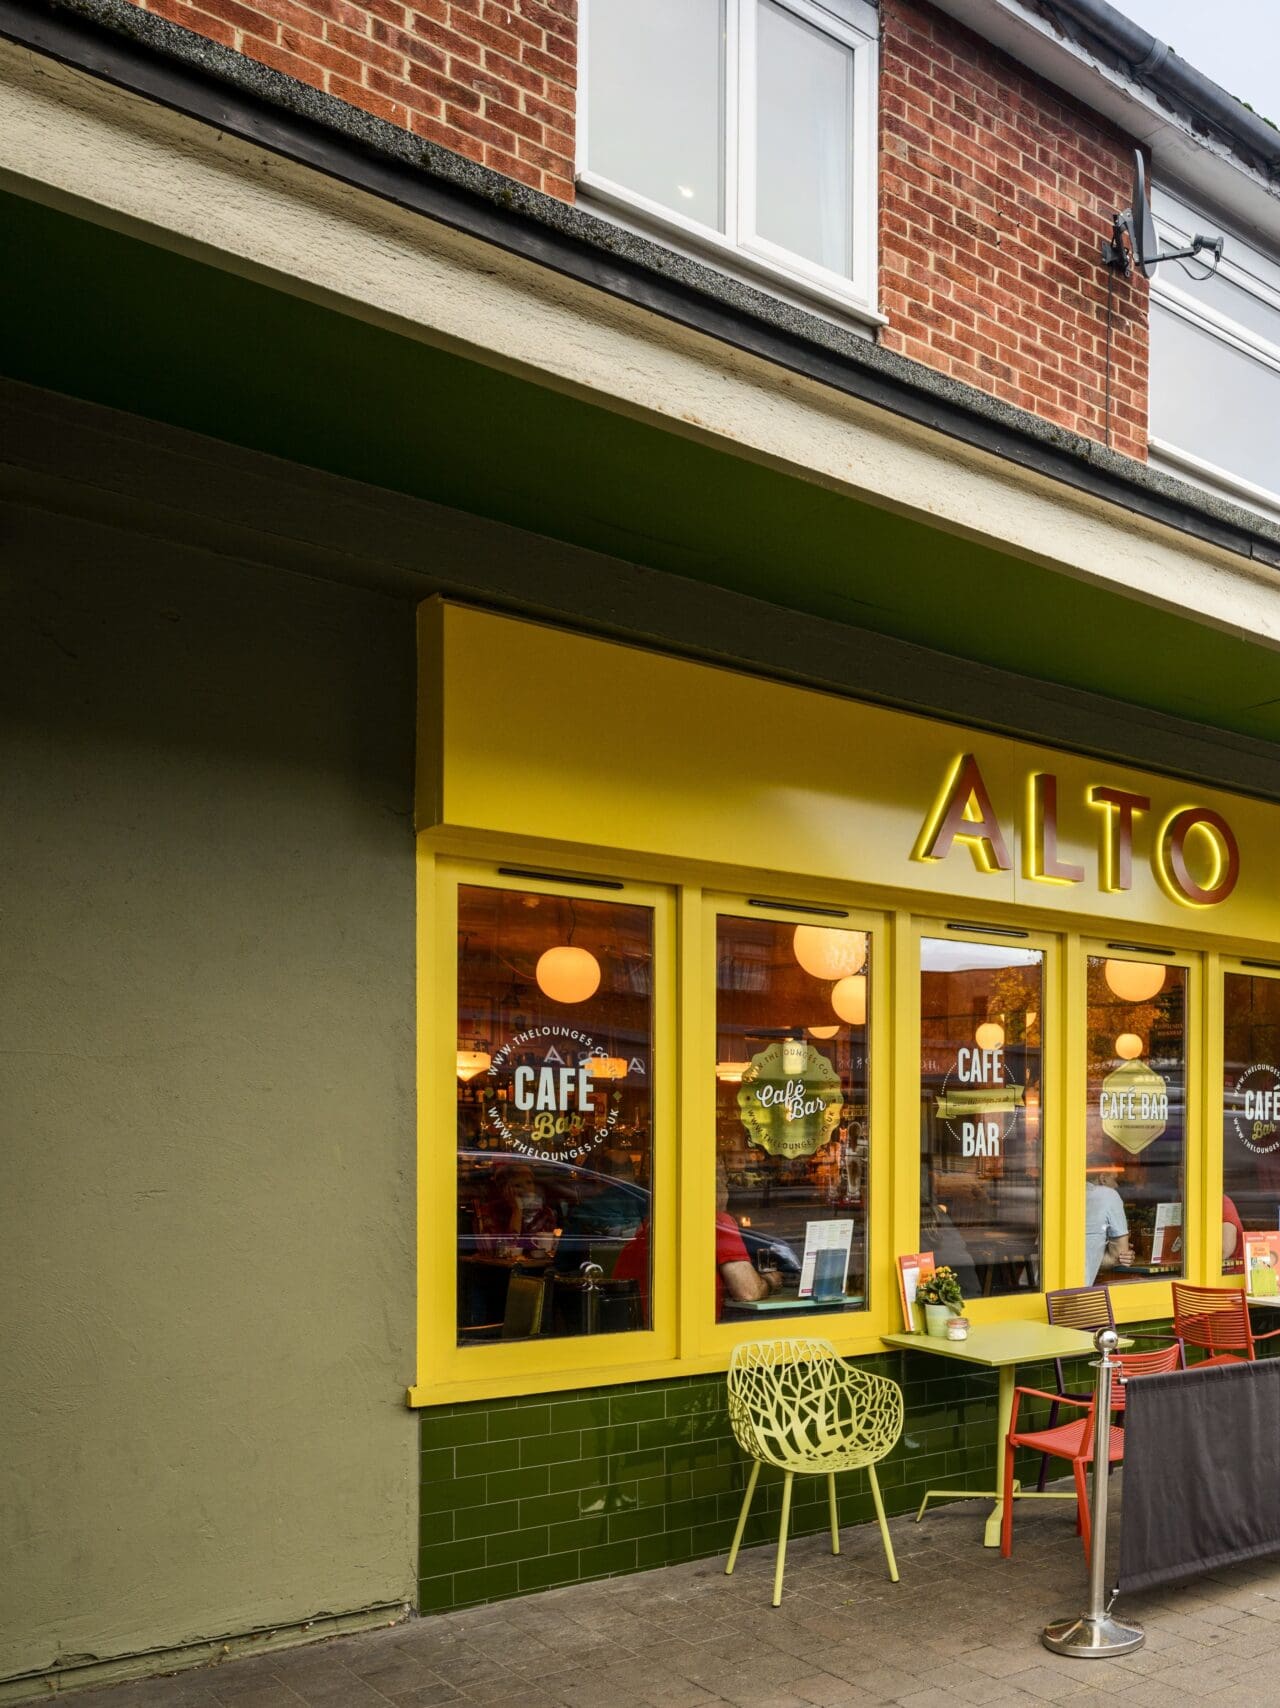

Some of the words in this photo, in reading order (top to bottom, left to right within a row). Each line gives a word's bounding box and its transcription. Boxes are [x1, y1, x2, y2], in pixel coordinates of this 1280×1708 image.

[910, 753, 1240, 908] ALTO
[958, 1042, 1004, 1083] CAFÉ
[514, 1057, 594, 1111] CAFÉ
[756, 1079, 807, 1109] Café
[1245, 1084, 1280, 1121] CAFÉ
[789, 1097, 827, 1120] Bar
[1100, 1086, 1136, 1121] CAFÉ
[1141, 1093, 1169, 1121] BAR
[488, 1106, 619, 1161] WWW.THELOUNGES.CO.UK
[531, 1111, 586, 1141] Bar
[962, 1121, 1000, 1158] BAR
[1251, 1121, 1277, 1140] Bar
